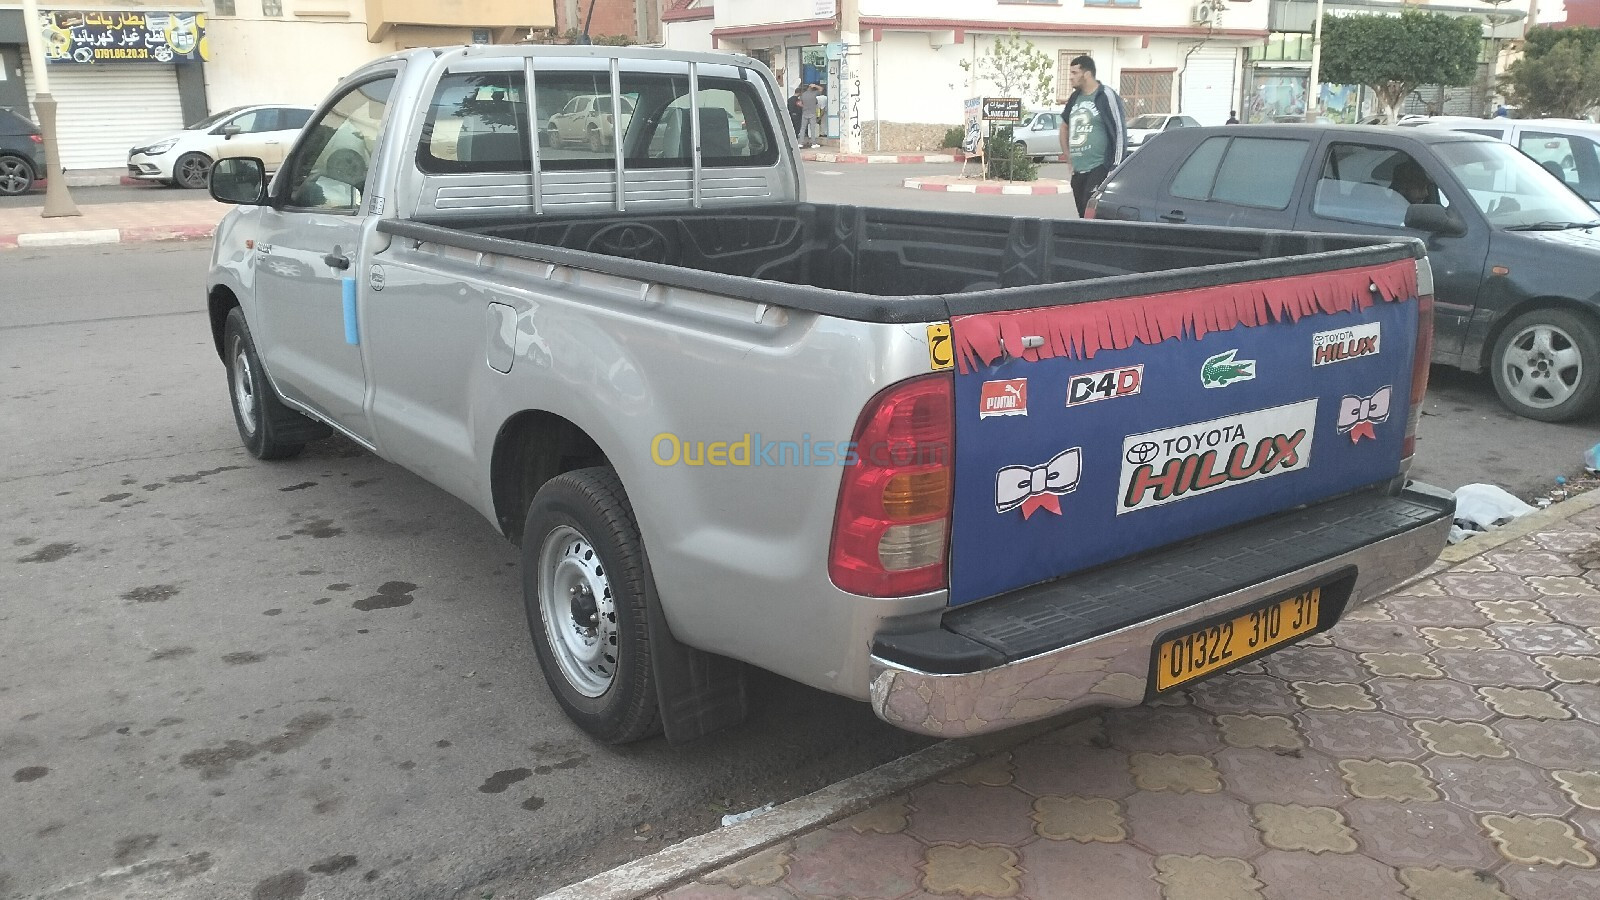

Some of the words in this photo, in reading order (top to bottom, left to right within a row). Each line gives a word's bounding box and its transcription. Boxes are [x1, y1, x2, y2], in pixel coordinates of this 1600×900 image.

[85, 12, 146, 30] بطاريات
[71, 29, 114, 46] كهربائية
[117, 28, 140, 46] غيار
[144, 28, 166, 47] قطع
[94, 49, 148, 59] 0791.86.20.31
[931, 327, 950, 365] خ
[1324, 331, 1354, 343] TOYOTA
[1315, 335, 1378, 364] HILUX
[986, 395, 1016, 409] PUMA
[1163, 424, 1245, 456] TOYOTA
[1124, 429, 1306, 507] HILUX
[1170, 621, 1234, 678] 01322
[1248, 604, 1281, 648] 310
[1292, 591, 1313, 630] 31
